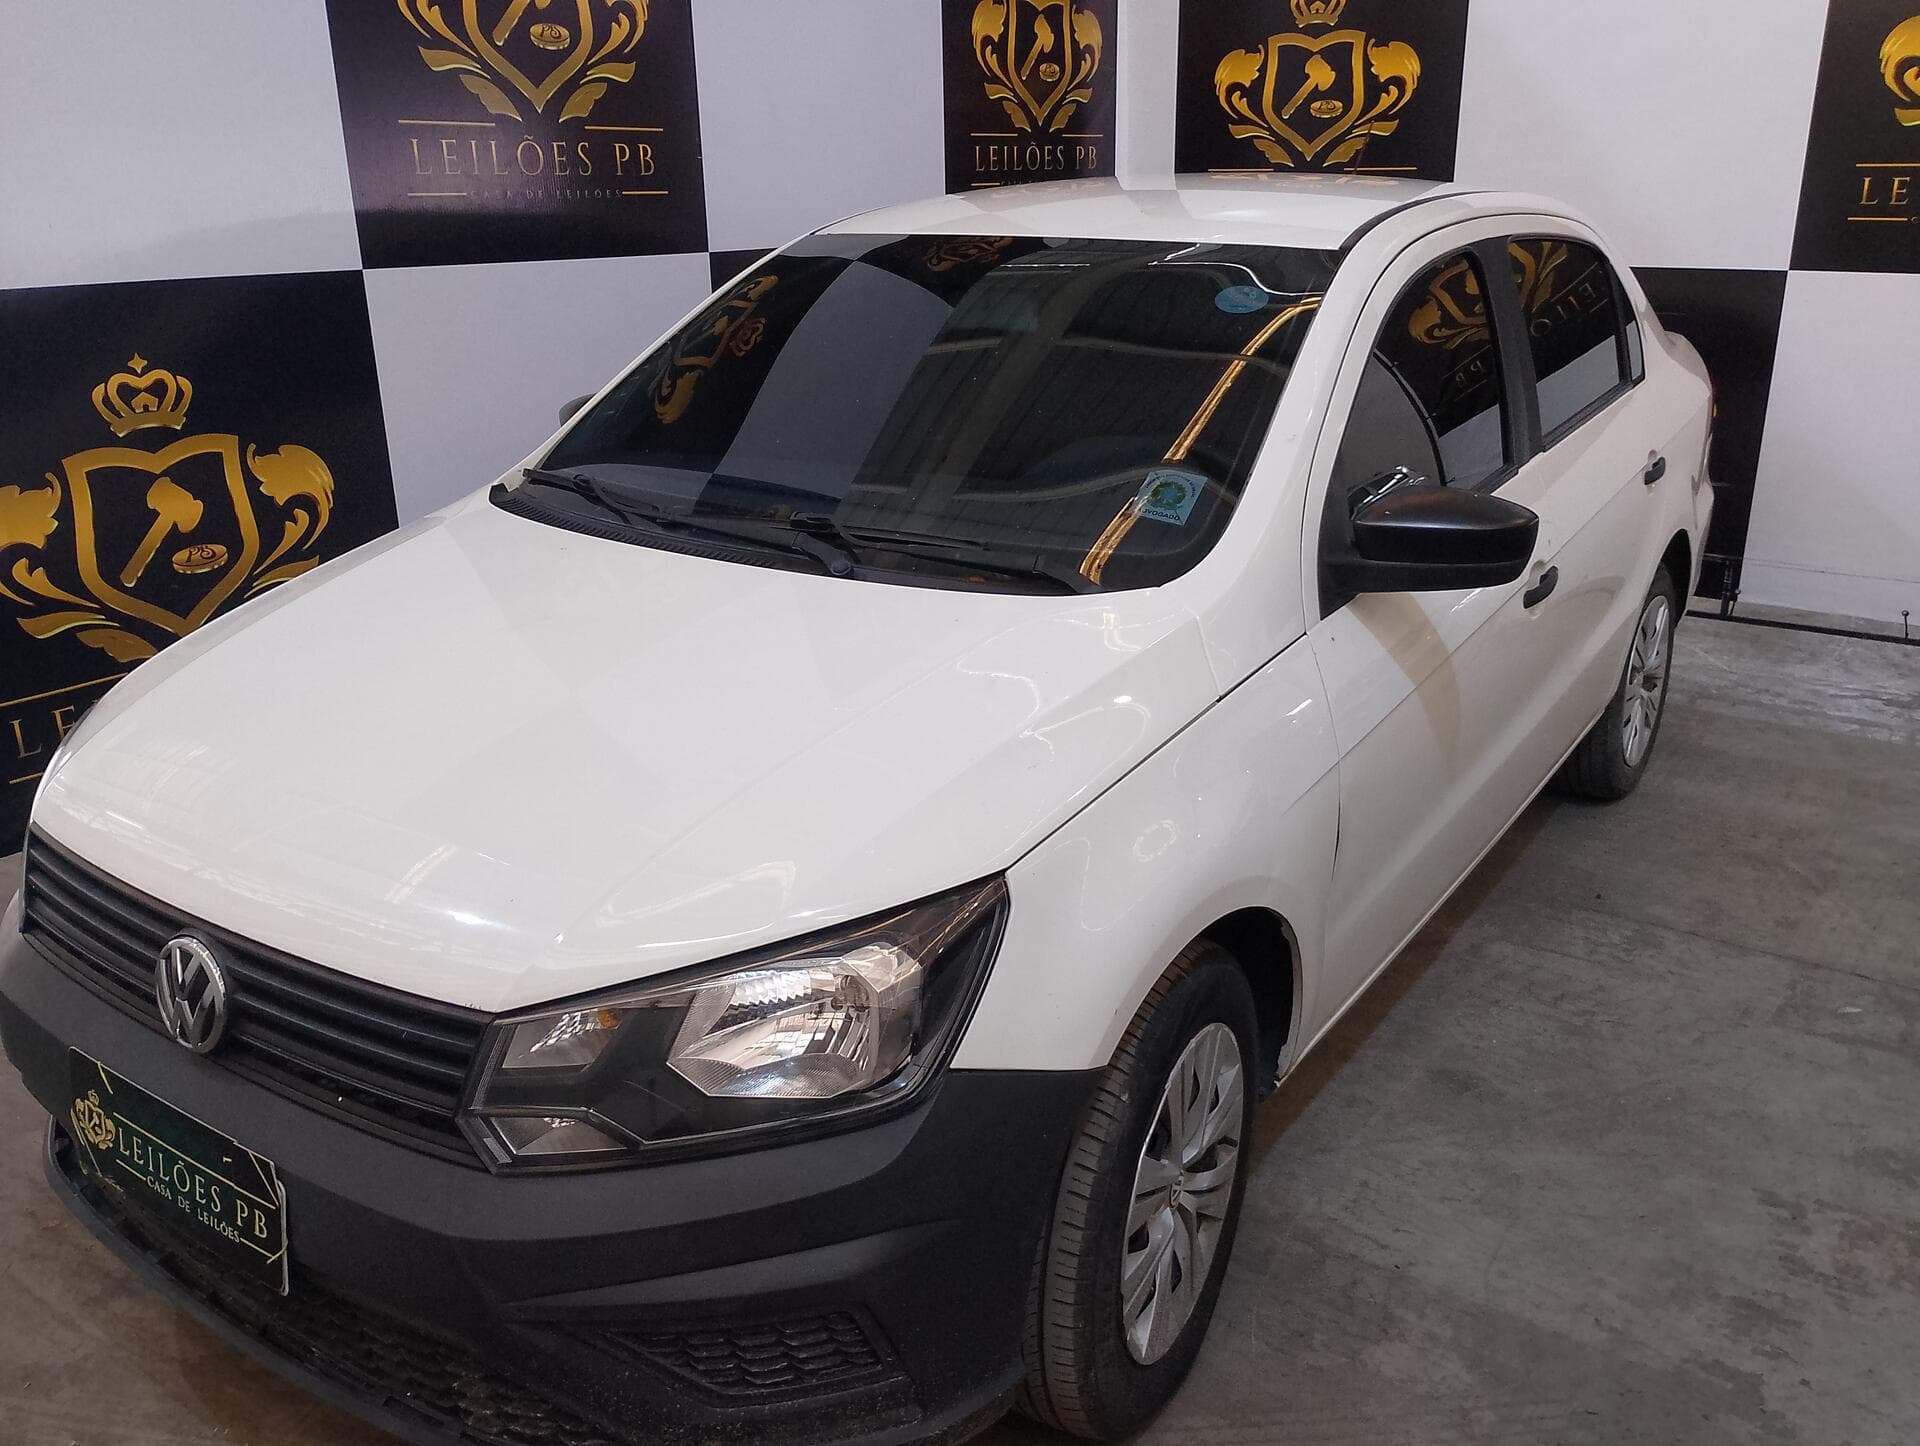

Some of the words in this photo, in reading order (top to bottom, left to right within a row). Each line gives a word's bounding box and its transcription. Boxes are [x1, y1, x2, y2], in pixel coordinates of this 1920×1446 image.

[410, 136, 593, 176] LEILÕES
[614, 142, 657, 176] PB
[974, 142, 1066, 172] LEILÕES
[1075, 145, 1098, 170] PB
[117, 1127, 222, 1213] LEILÕES
[235, 1198, 268, 1239] PB
[146, 1175, 173, 1201] CASA
[177, 1197, 192, 1213] DE
[197, 1207, 241, 1244] LEILÕES
